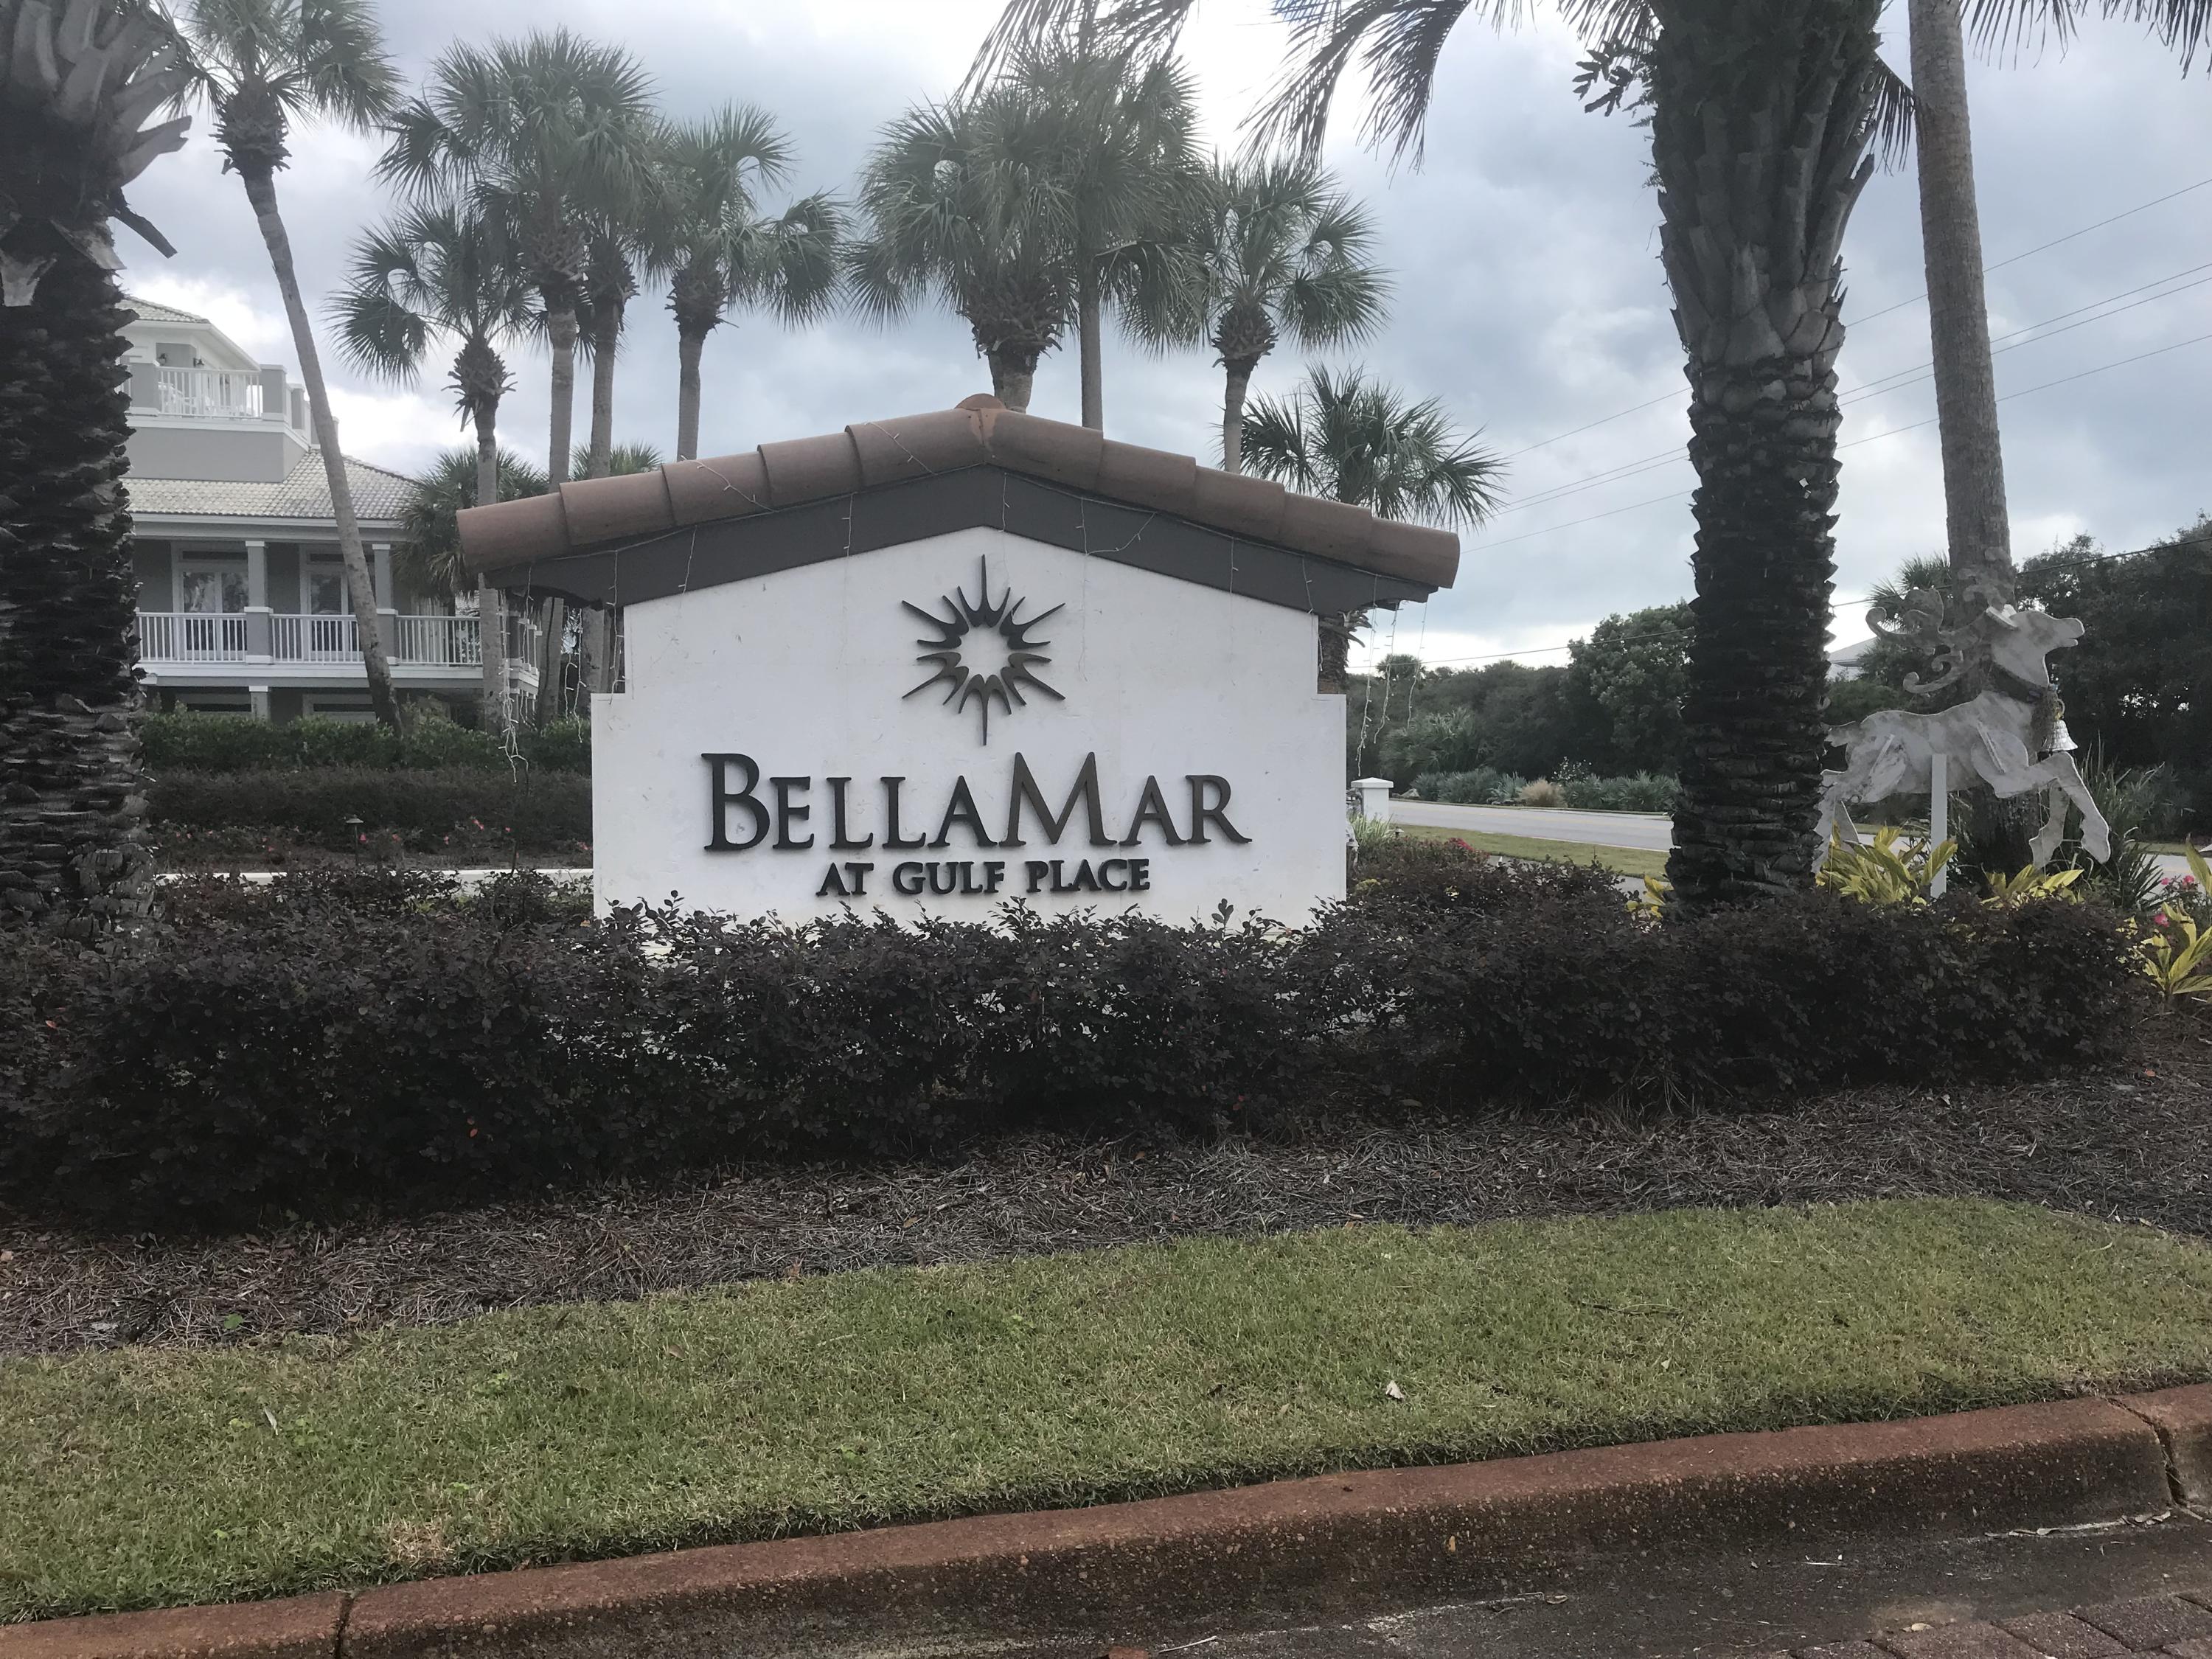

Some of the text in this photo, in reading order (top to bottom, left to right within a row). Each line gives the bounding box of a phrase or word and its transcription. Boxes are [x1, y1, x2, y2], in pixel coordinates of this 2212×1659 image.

[815, 858, 1151, 898] AT GULF PLACE
